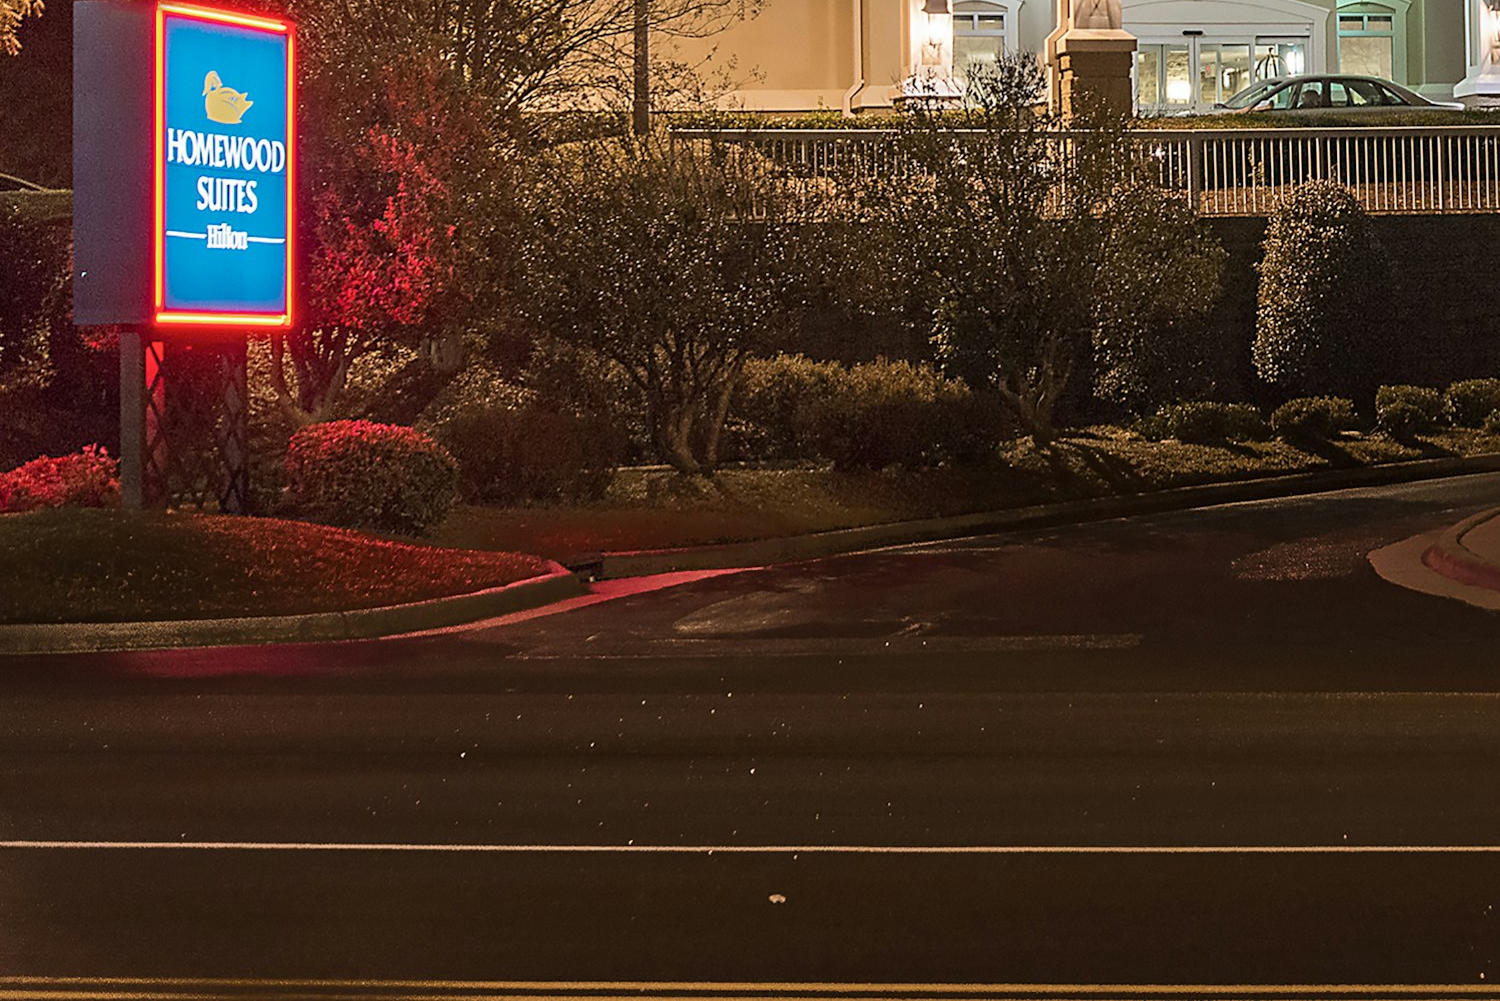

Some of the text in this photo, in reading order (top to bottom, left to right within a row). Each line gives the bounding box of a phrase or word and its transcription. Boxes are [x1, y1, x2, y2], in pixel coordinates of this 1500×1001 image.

[167, 127, 286, 172] HOMEWOOD
[196, 176, 258, 214] SUITES
[206, 223, 248, 249] Hilton
